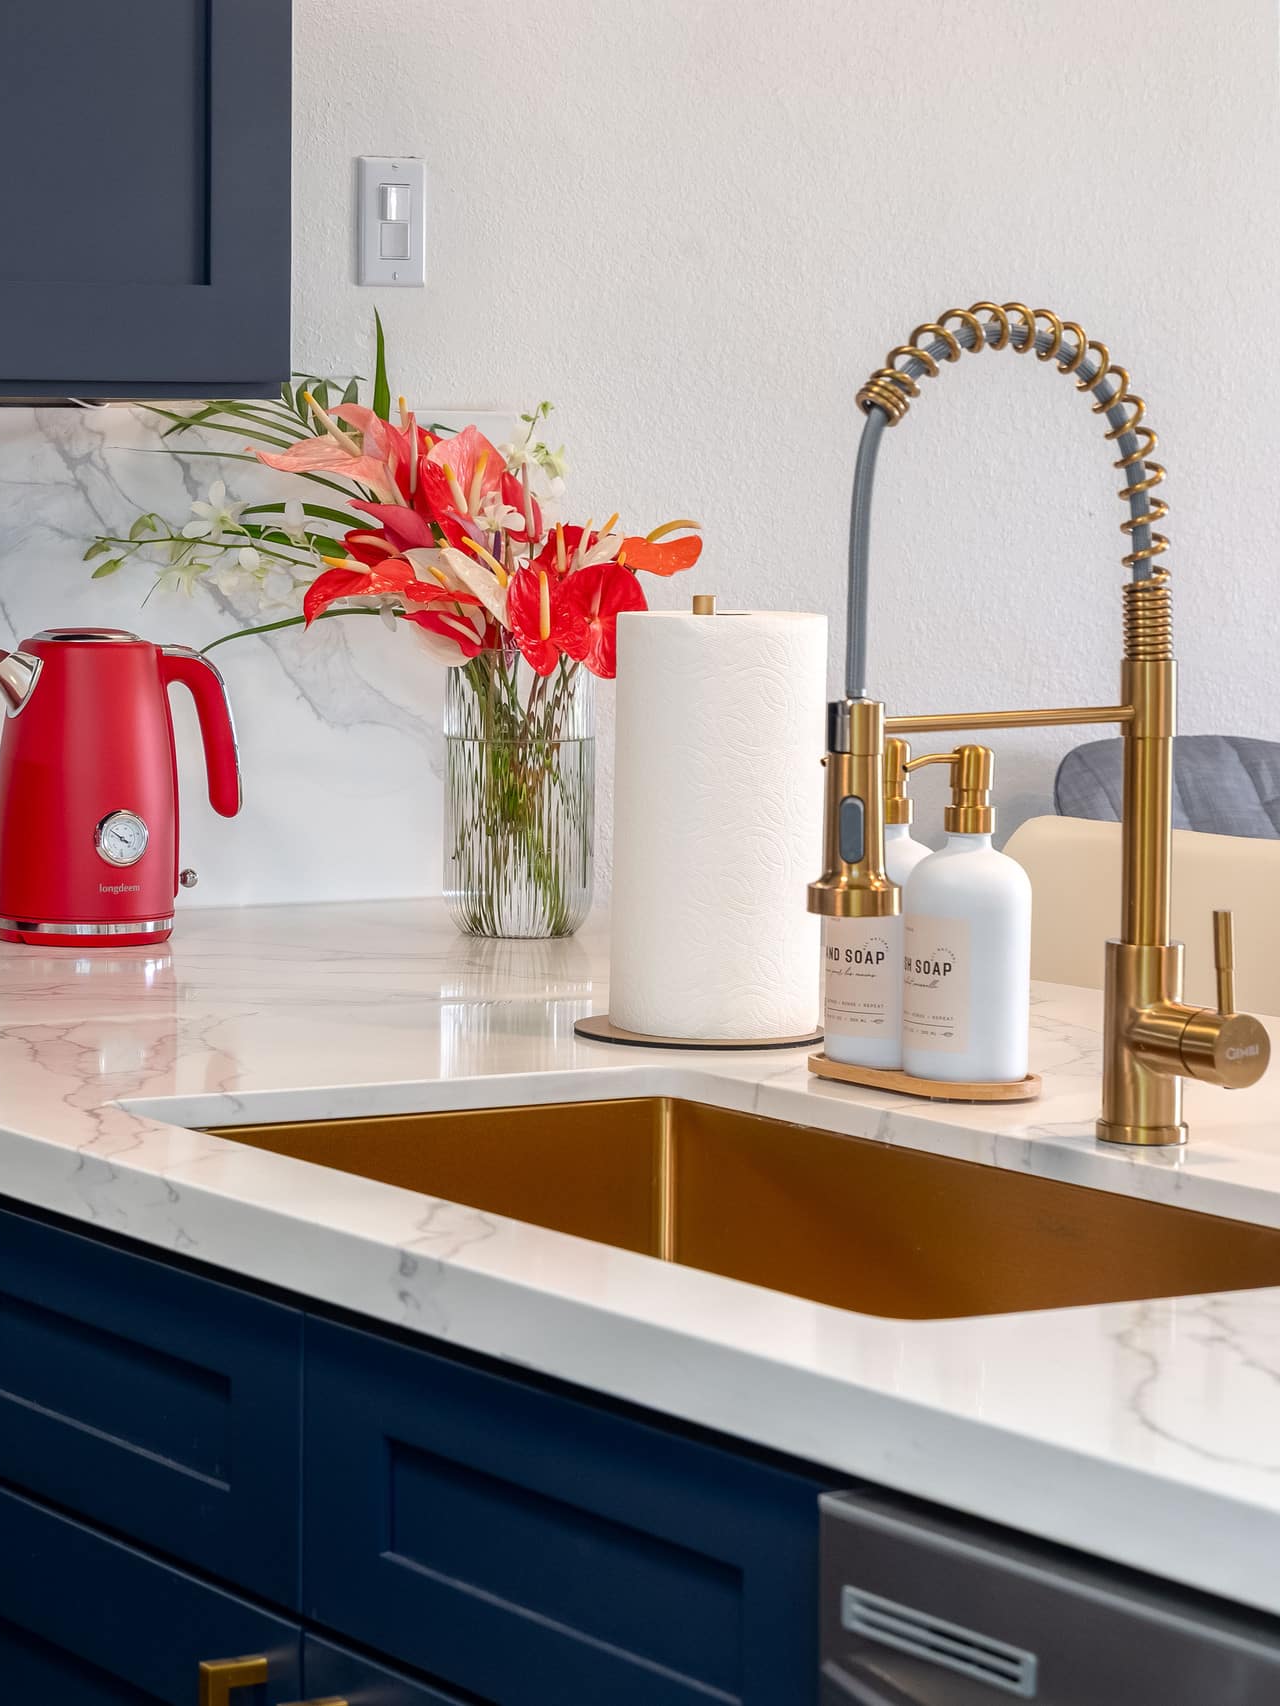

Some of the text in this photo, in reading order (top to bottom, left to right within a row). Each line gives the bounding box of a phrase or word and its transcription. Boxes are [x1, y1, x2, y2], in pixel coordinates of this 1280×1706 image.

[99, 883, 141, 894] longdeem
[845, 948, 885, 965] SOAP
[915, 959, 952, 976] SOAP
